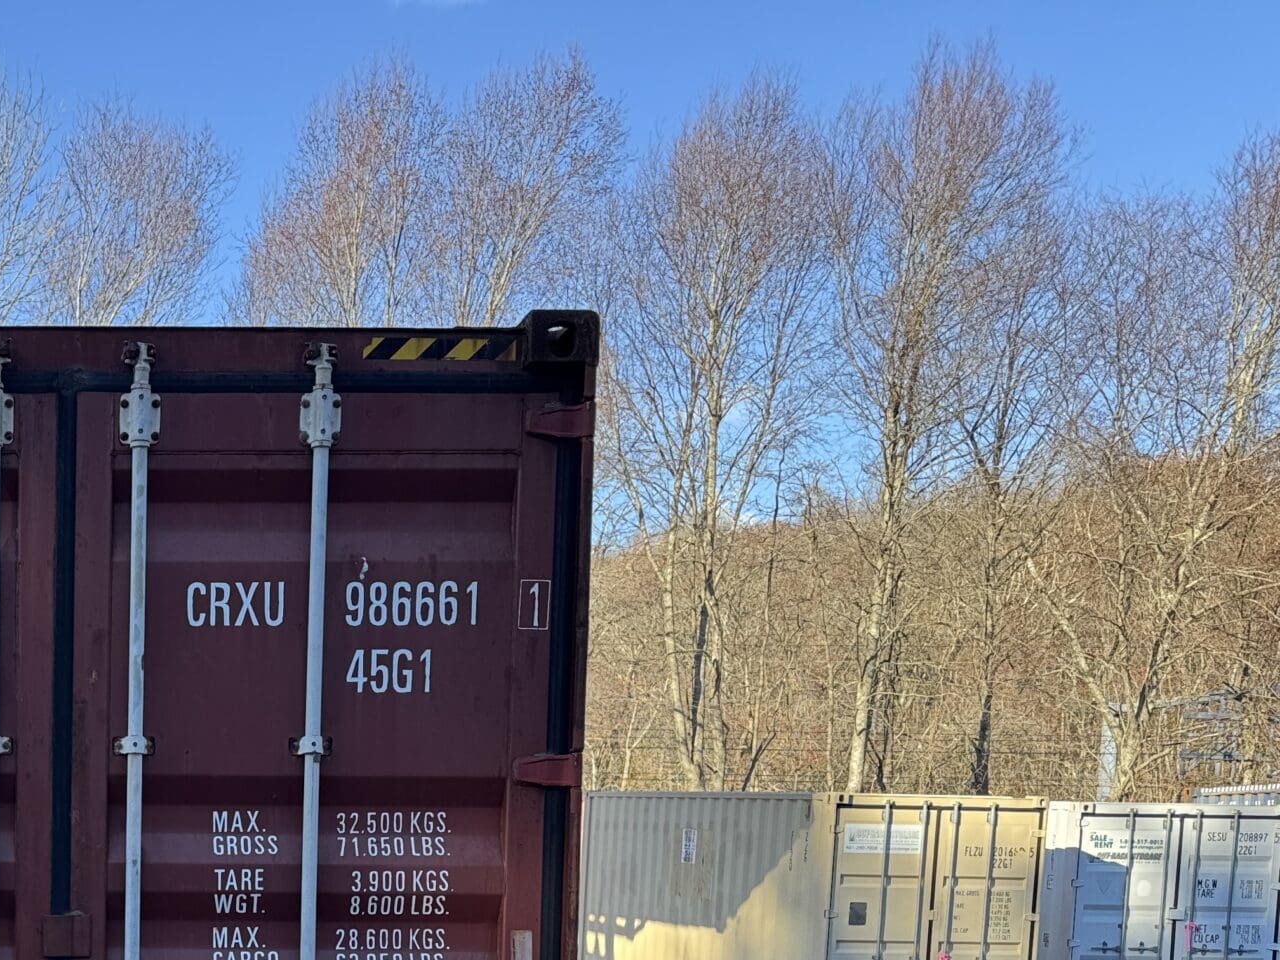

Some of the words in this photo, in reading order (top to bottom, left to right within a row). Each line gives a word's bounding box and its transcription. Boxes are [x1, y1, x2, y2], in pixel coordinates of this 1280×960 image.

[186, 581, 285, 627] CRXU
[345, 581, 478, 627] 986661
[529, 582, 539, 627] 1
[346, 649, 432, 694] 45G1
[212, 810, 266, 833] MAX.
[336, 811, 404, 835] 32.500
[410, 811, 452, 834] KGS.
[212, 835, 279, 856] GROSS
[337, 836, 405, 857] 71.650
[410, 836, 451, 857] LBS.
[1207, 832, 1227, 842] SESU
[965, 846, 983, 857] FLZU
[1029, 847, 1035, 858] 5
[214, 868, 265, 891] TARE
[351, 870, 406, 893] 3.900
[412, 869, 455, 892] KGS.
[213, 893, 266, 914] WGT.
[349, 895, 405, 917] 8.600
[410, 895, 450, 915] LBS.
[212, 926, 266, 949] MAX.
[335, 928, 403, 951] 28.600
[408, 928, 451, 950] KGS.
